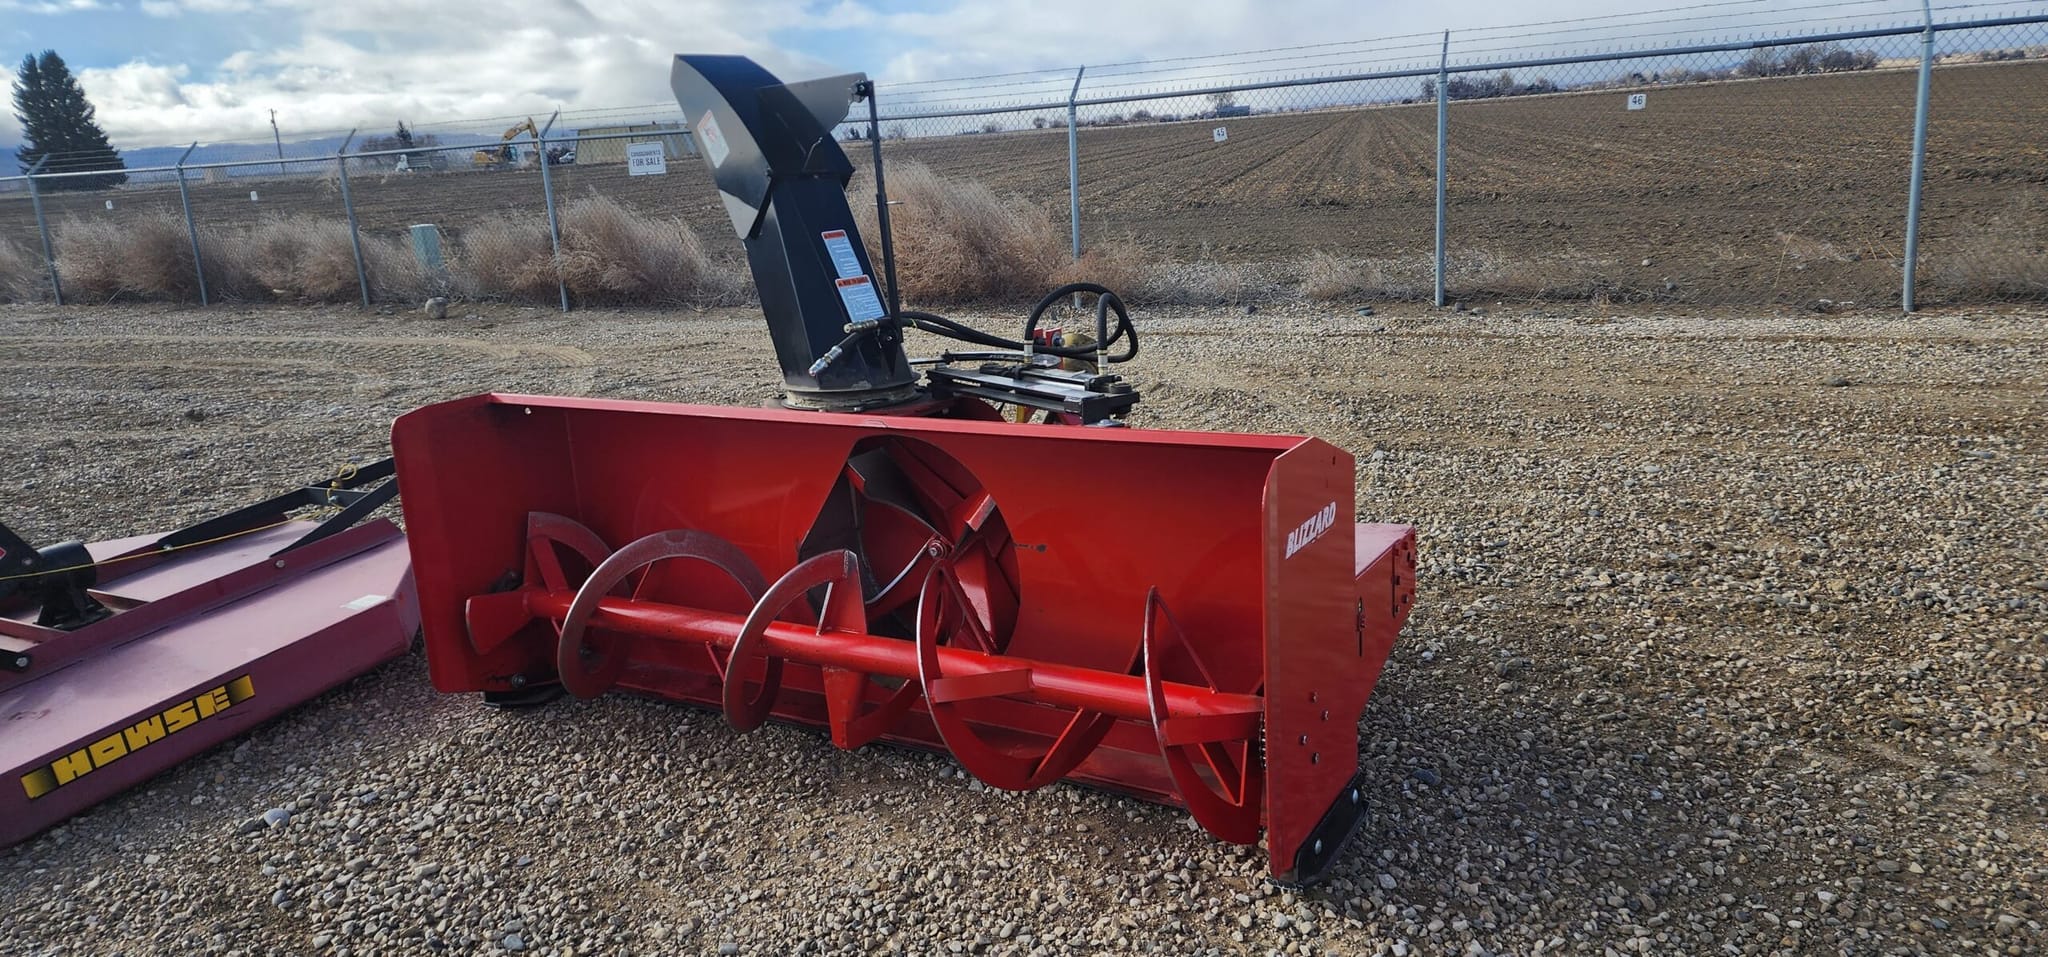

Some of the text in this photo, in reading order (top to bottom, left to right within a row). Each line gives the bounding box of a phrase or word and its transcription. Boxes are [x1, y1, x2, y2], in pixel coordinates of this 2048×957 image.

[1632, 95, 1643, 105] 46
[632, 157, 660, 167] FOR SALE
[1285, 501, 1336, 560] BLIZZARD
[51, 686, 231, 786] HOWSE
